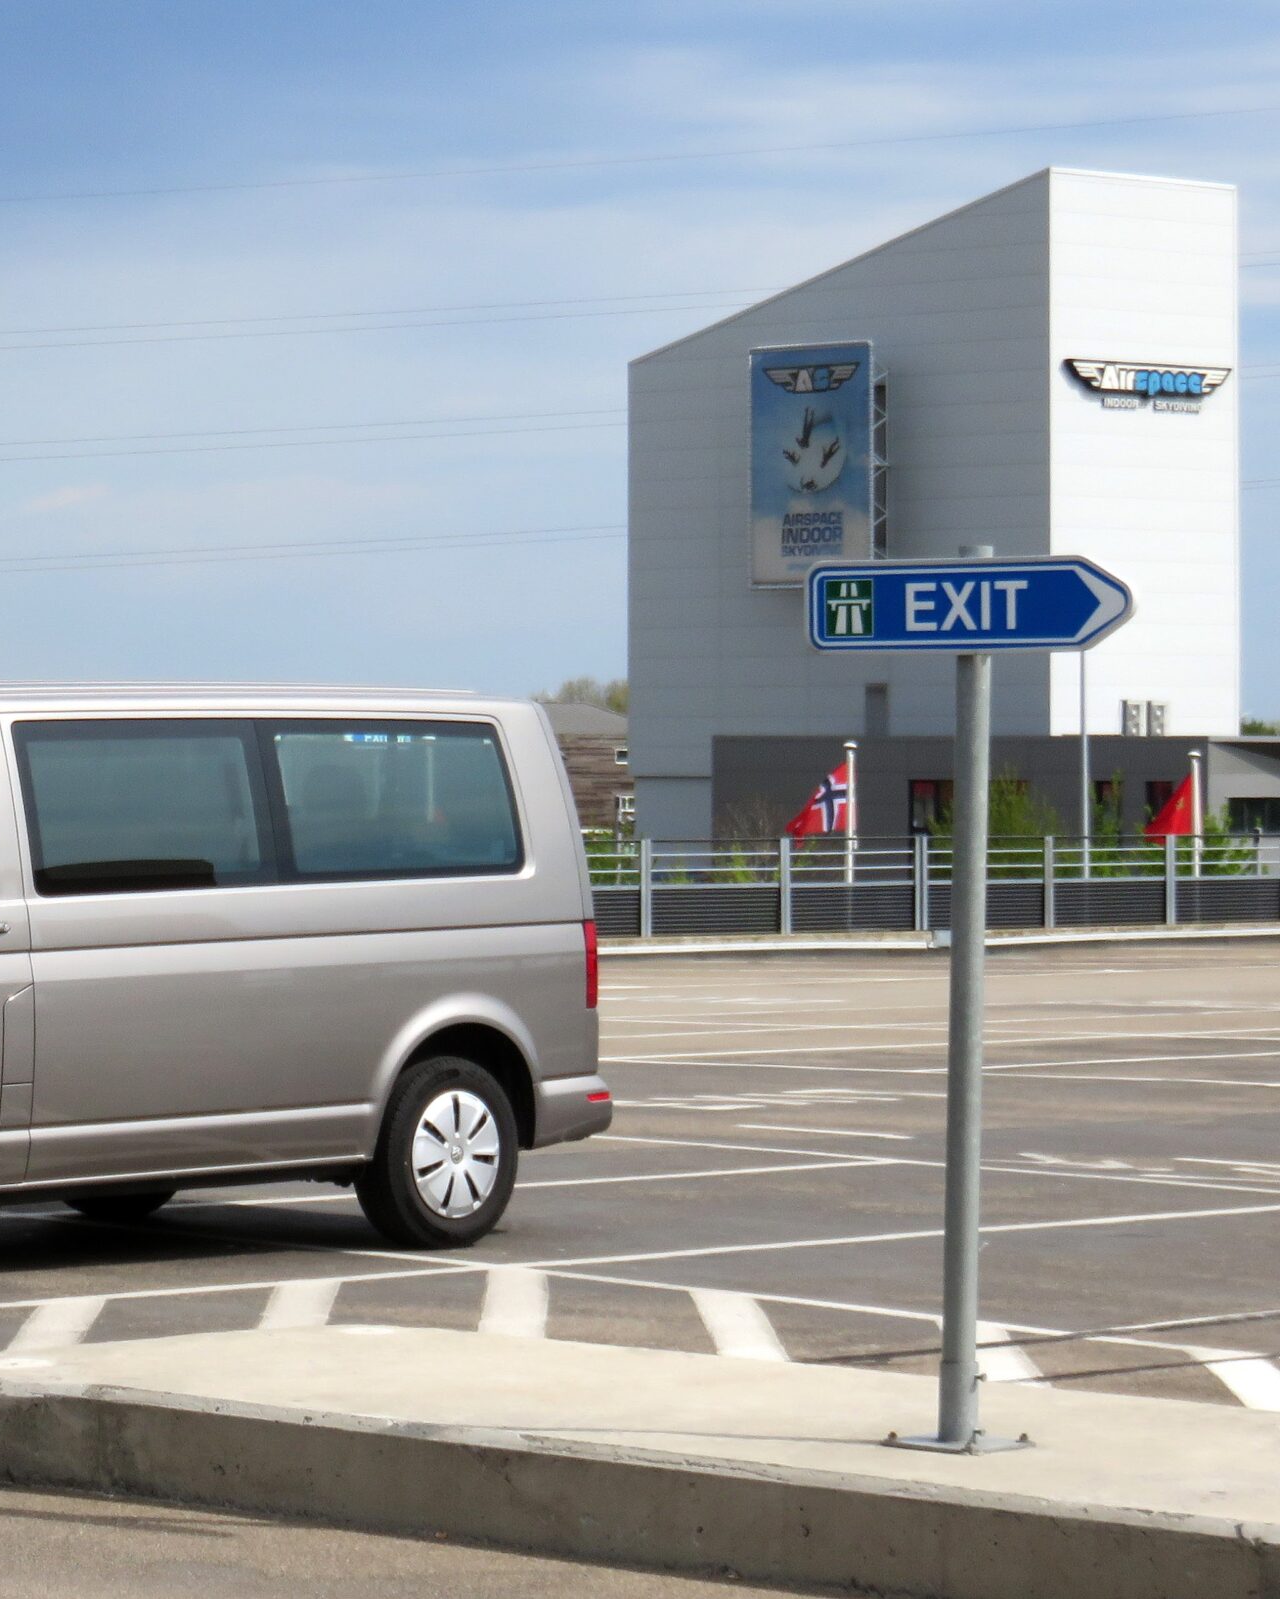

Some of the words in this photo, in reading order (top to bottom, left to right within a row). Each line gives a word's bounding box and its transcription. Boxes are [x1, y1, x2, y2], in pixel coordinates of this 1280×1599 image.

[1100, 364, 1201, 395] Airspace
[1103, 398, 1138, 409] INDOOR
[783, 512, 842, 527] AIRSPACE
[782, 527, 842, 544] INDOOR
[905, 580, 1028, 631] EXIT
